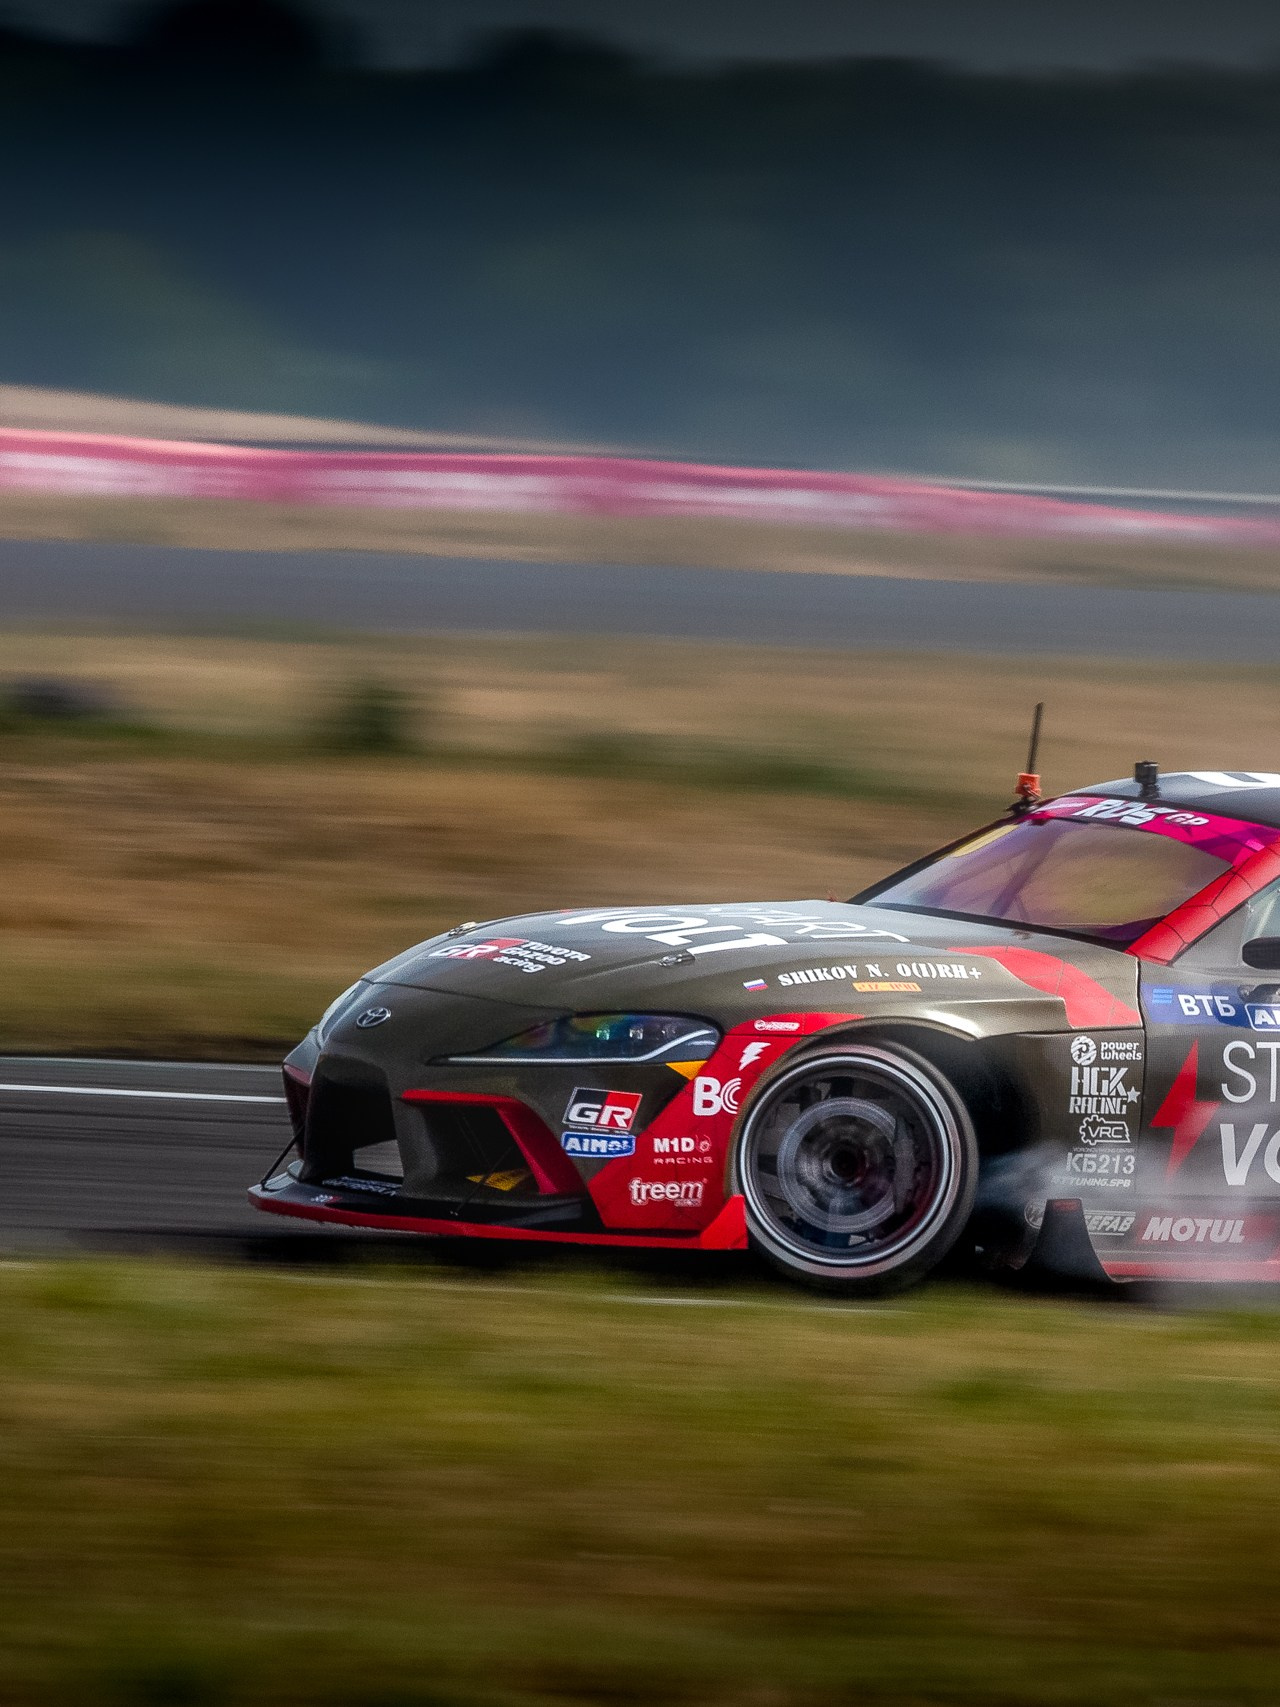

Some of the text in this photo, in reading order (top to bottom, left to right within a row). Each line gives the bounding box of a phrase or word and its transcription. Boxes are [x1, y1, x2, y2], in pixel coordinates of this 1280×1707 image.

[777, 964, 859, 987] SHIKOV
[865, 963, 890, 979] N.
[1177, 994, 1236, 1017] ВТБ
[1101, 1042, 1139, 1051] power
[1101, 1050, 1142, 1060] wheels
[568, 1102, 633, 1128] GR
[1069, 1096, 1127, 1114] RACING
[1087, 1126, 1124, 1138] VRC
[630, 1178, 703, 1201] freem
[1141, 1216, 1246, 1243] MOTUL
